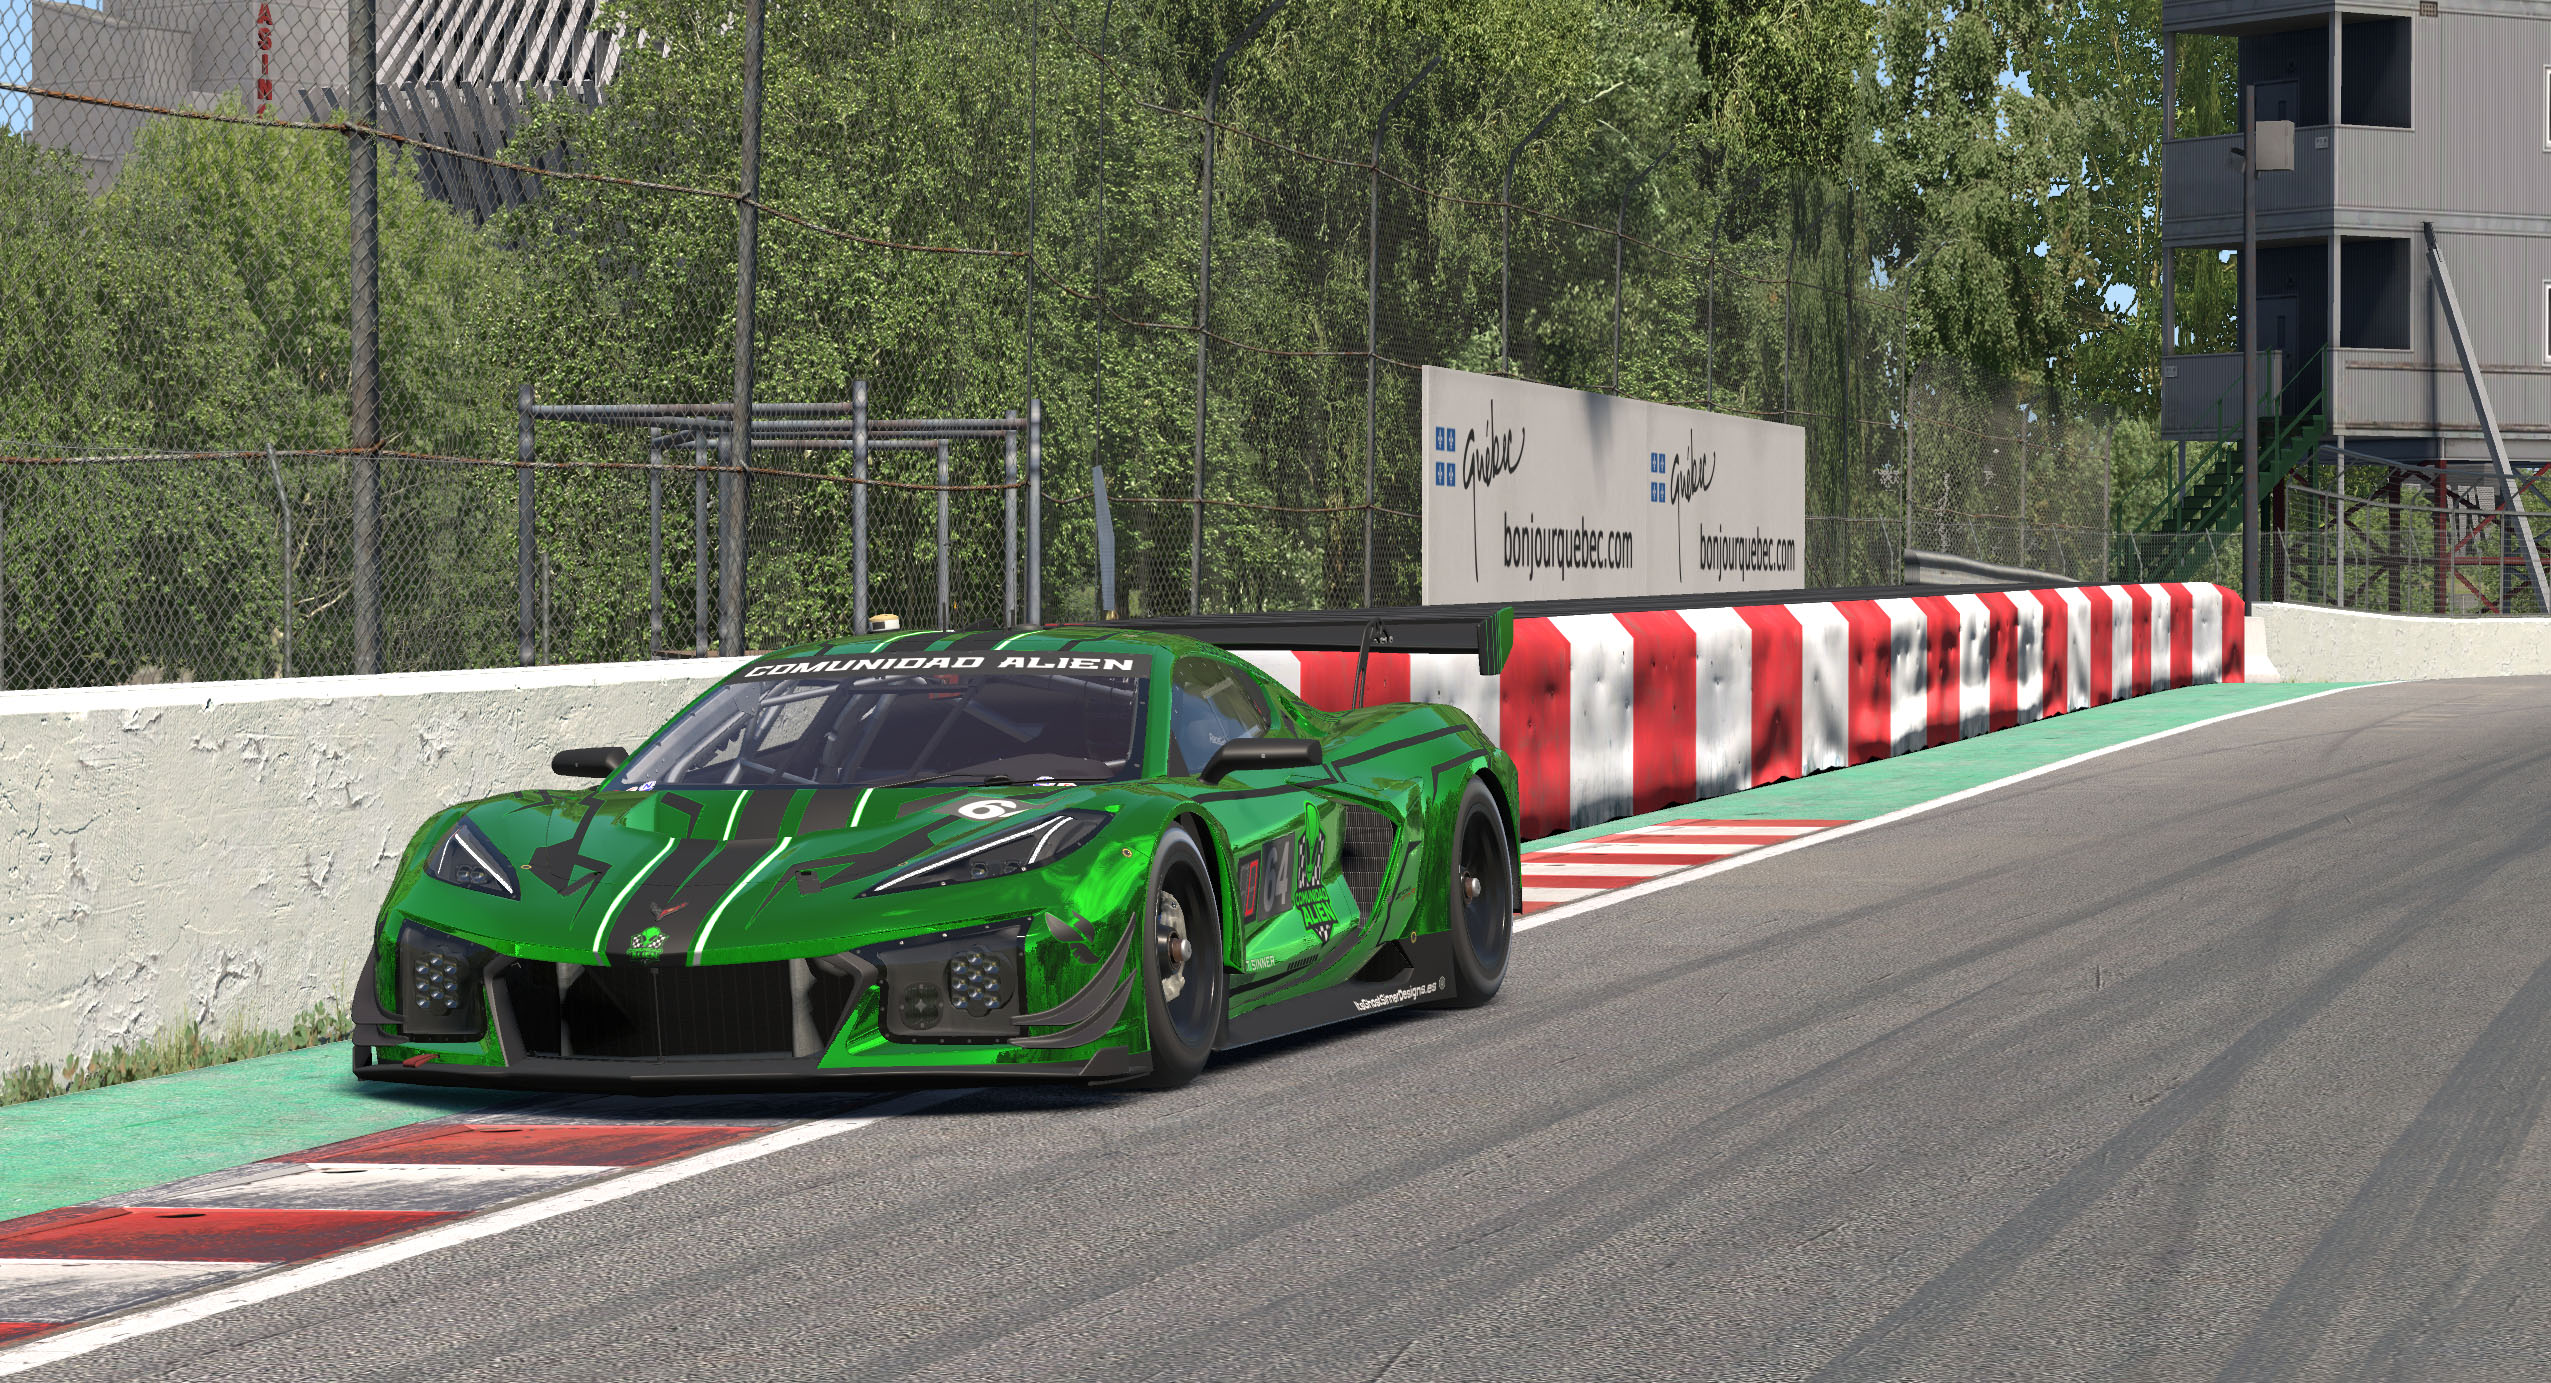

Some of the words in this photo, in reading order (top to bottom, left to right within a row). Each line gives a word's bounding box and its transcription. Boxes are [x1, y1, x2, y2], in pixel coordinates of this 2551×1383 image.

[1462, 399, 1526, 583] Québec
[1670, 428, 1717, 583] Québec
[1503, 511, 1634, 582] bonjourquebec.com
[1700, 522, 1796, 582] bonjourquebec.com
[744, 656, 986, 678] COMUNIDAD
[999, 656, 1134, 671] ALIEN
[958, 799, 1032, 819] 6
[1263, 841, 1290, 912] 64
[1295, 887, 1329, 907] COMUNIDAD
[1301, 901, 1337, 928] ALIEN
[1251, 955, 1276, 971] SINNER
